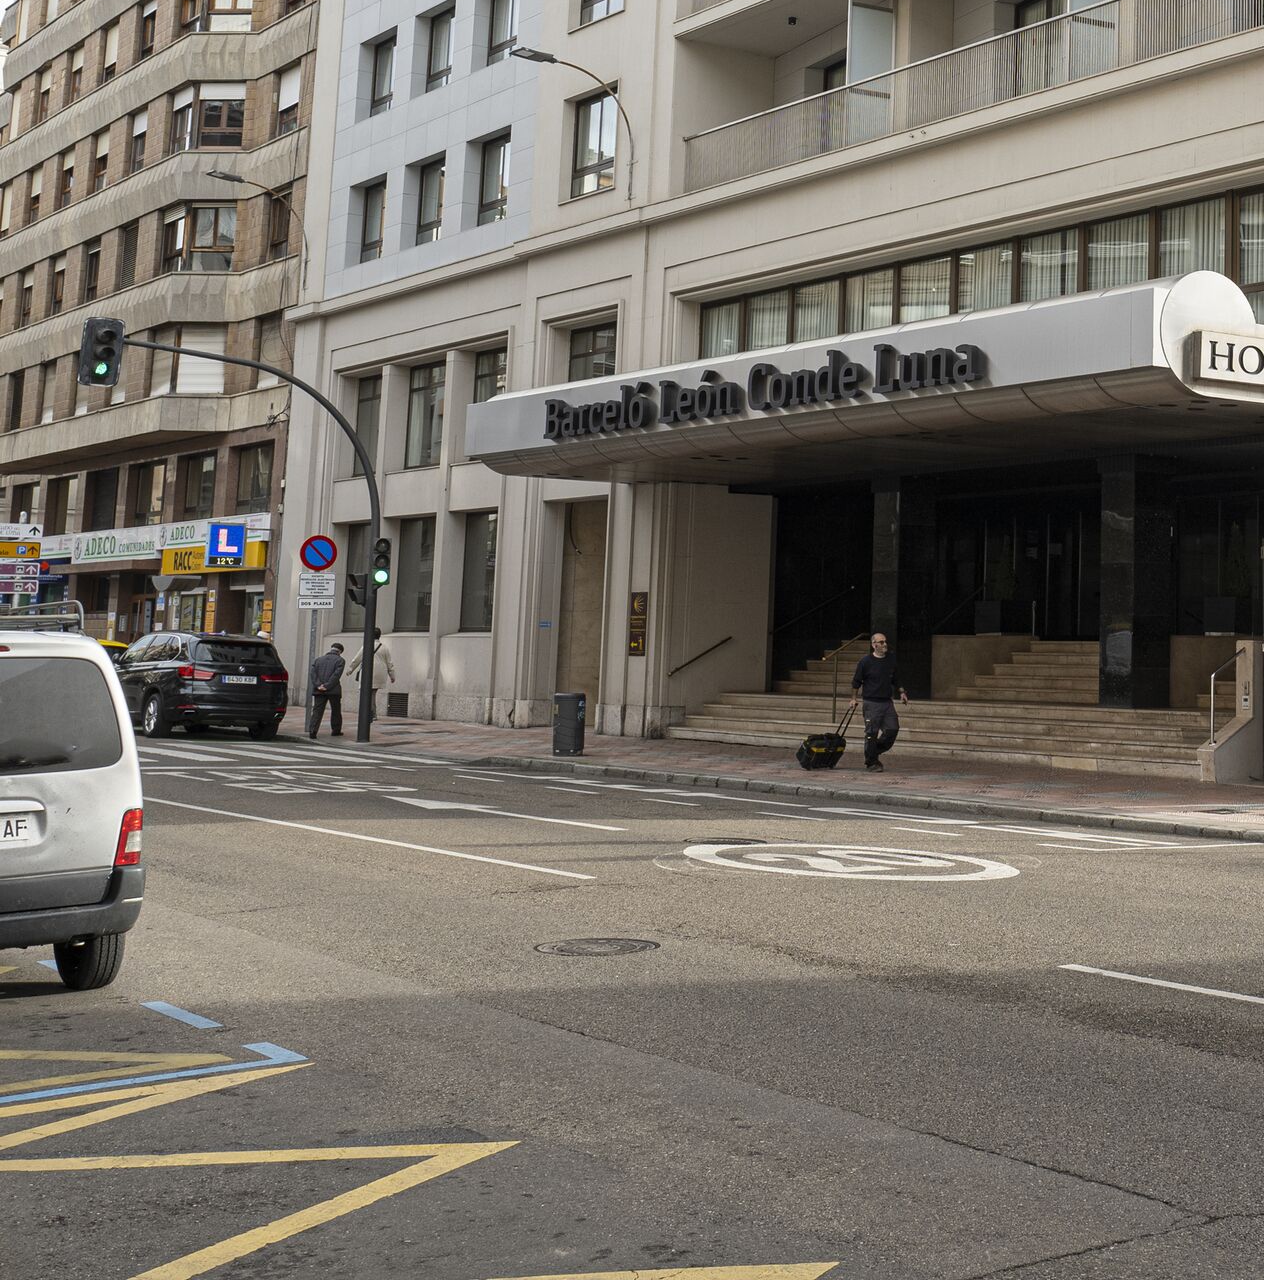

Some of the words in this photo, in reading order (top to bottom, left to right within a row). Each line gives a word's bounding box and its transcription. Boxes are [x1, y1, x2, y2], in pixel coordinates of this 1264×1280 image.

[543, 382, 652, 440] Barceló
[658, 370, 741, 424] León
[747, 349, 867, 411] Conde
[872, 342, 985, 394] Luna
[170, 525, 195, 541] ADECO
[84, 536, 116, 556] ADECO
[119, 541, 155, 553] COMUNIDADES
[173, 551, 192, 570] RACC
[3, 819, 26, 838] AF
